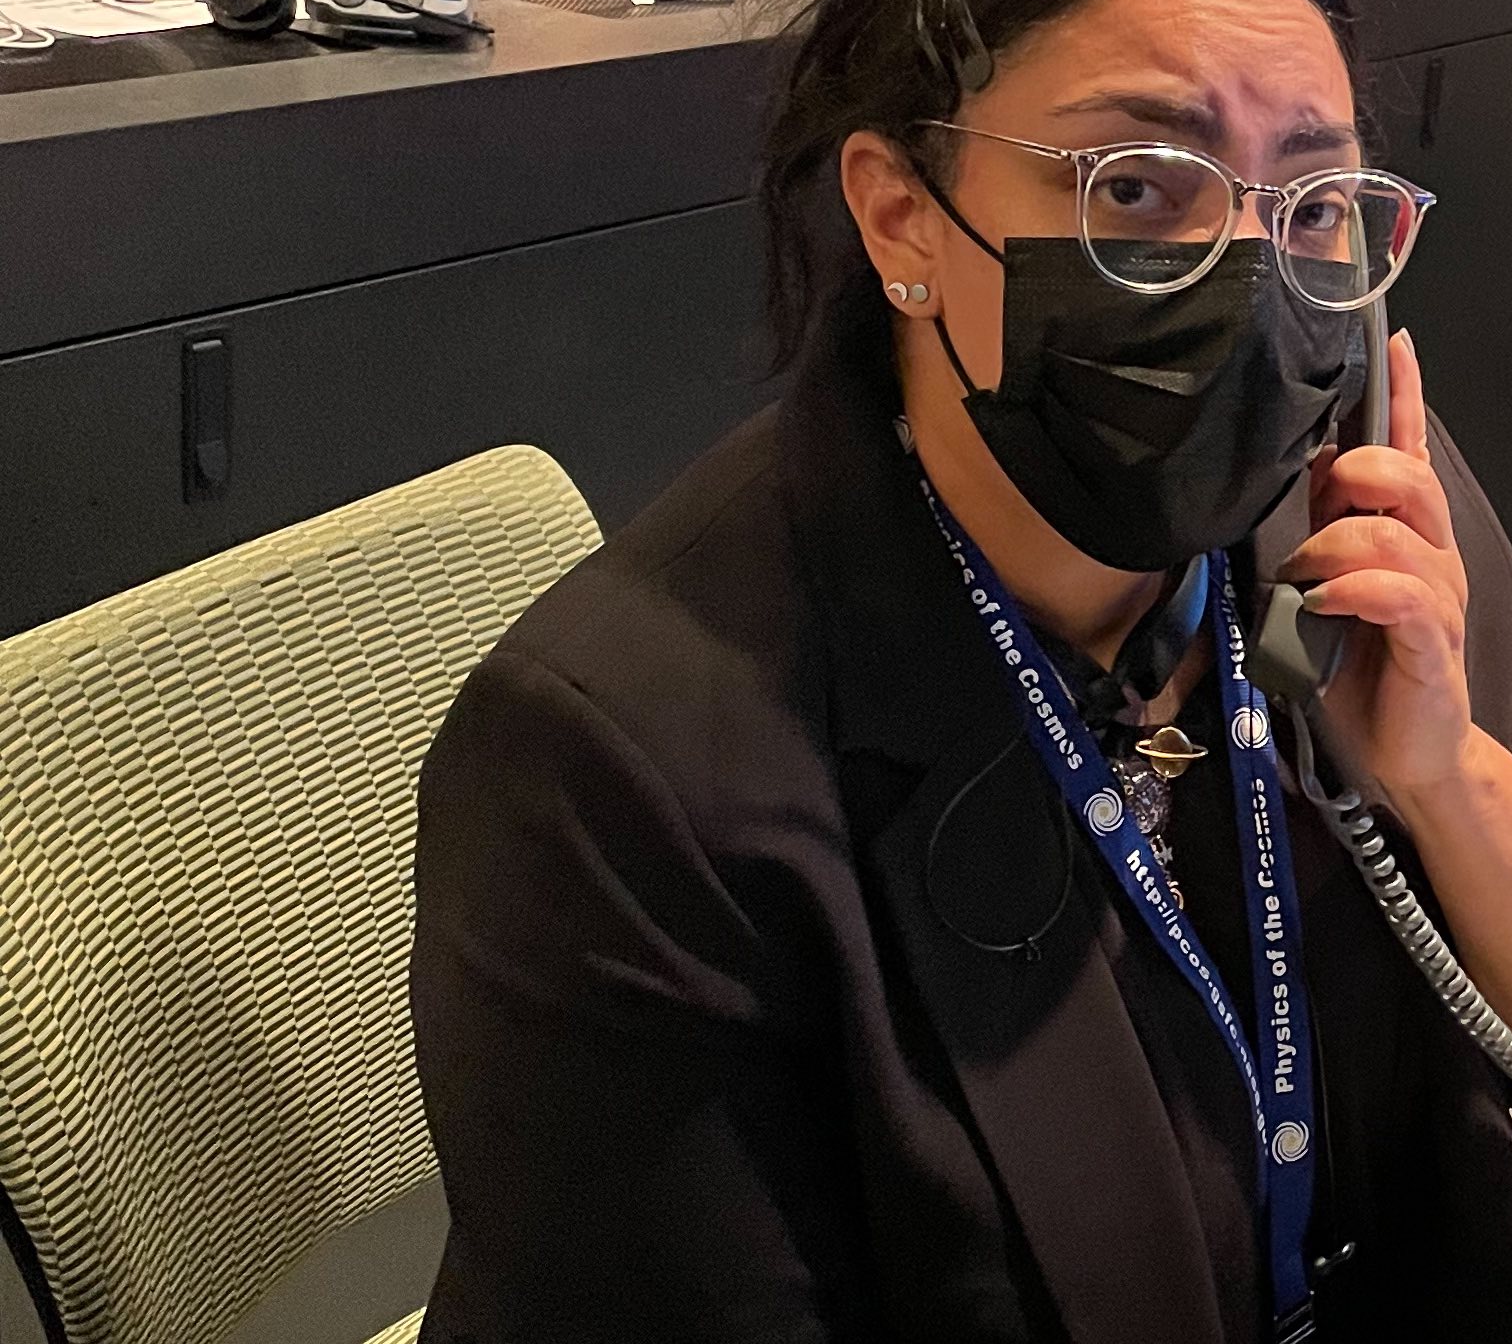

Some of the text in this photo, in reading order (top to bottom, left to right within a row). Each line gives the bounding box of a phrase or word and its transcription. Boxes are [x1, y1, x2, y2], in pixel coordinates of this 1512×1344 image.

[972, 589, 1083, 770] of the Cosmos
[1263, 895, 1284, 942] the
[1266, 950, 1288, 977] of
[1271, 982, 1297, 1094] Physics
